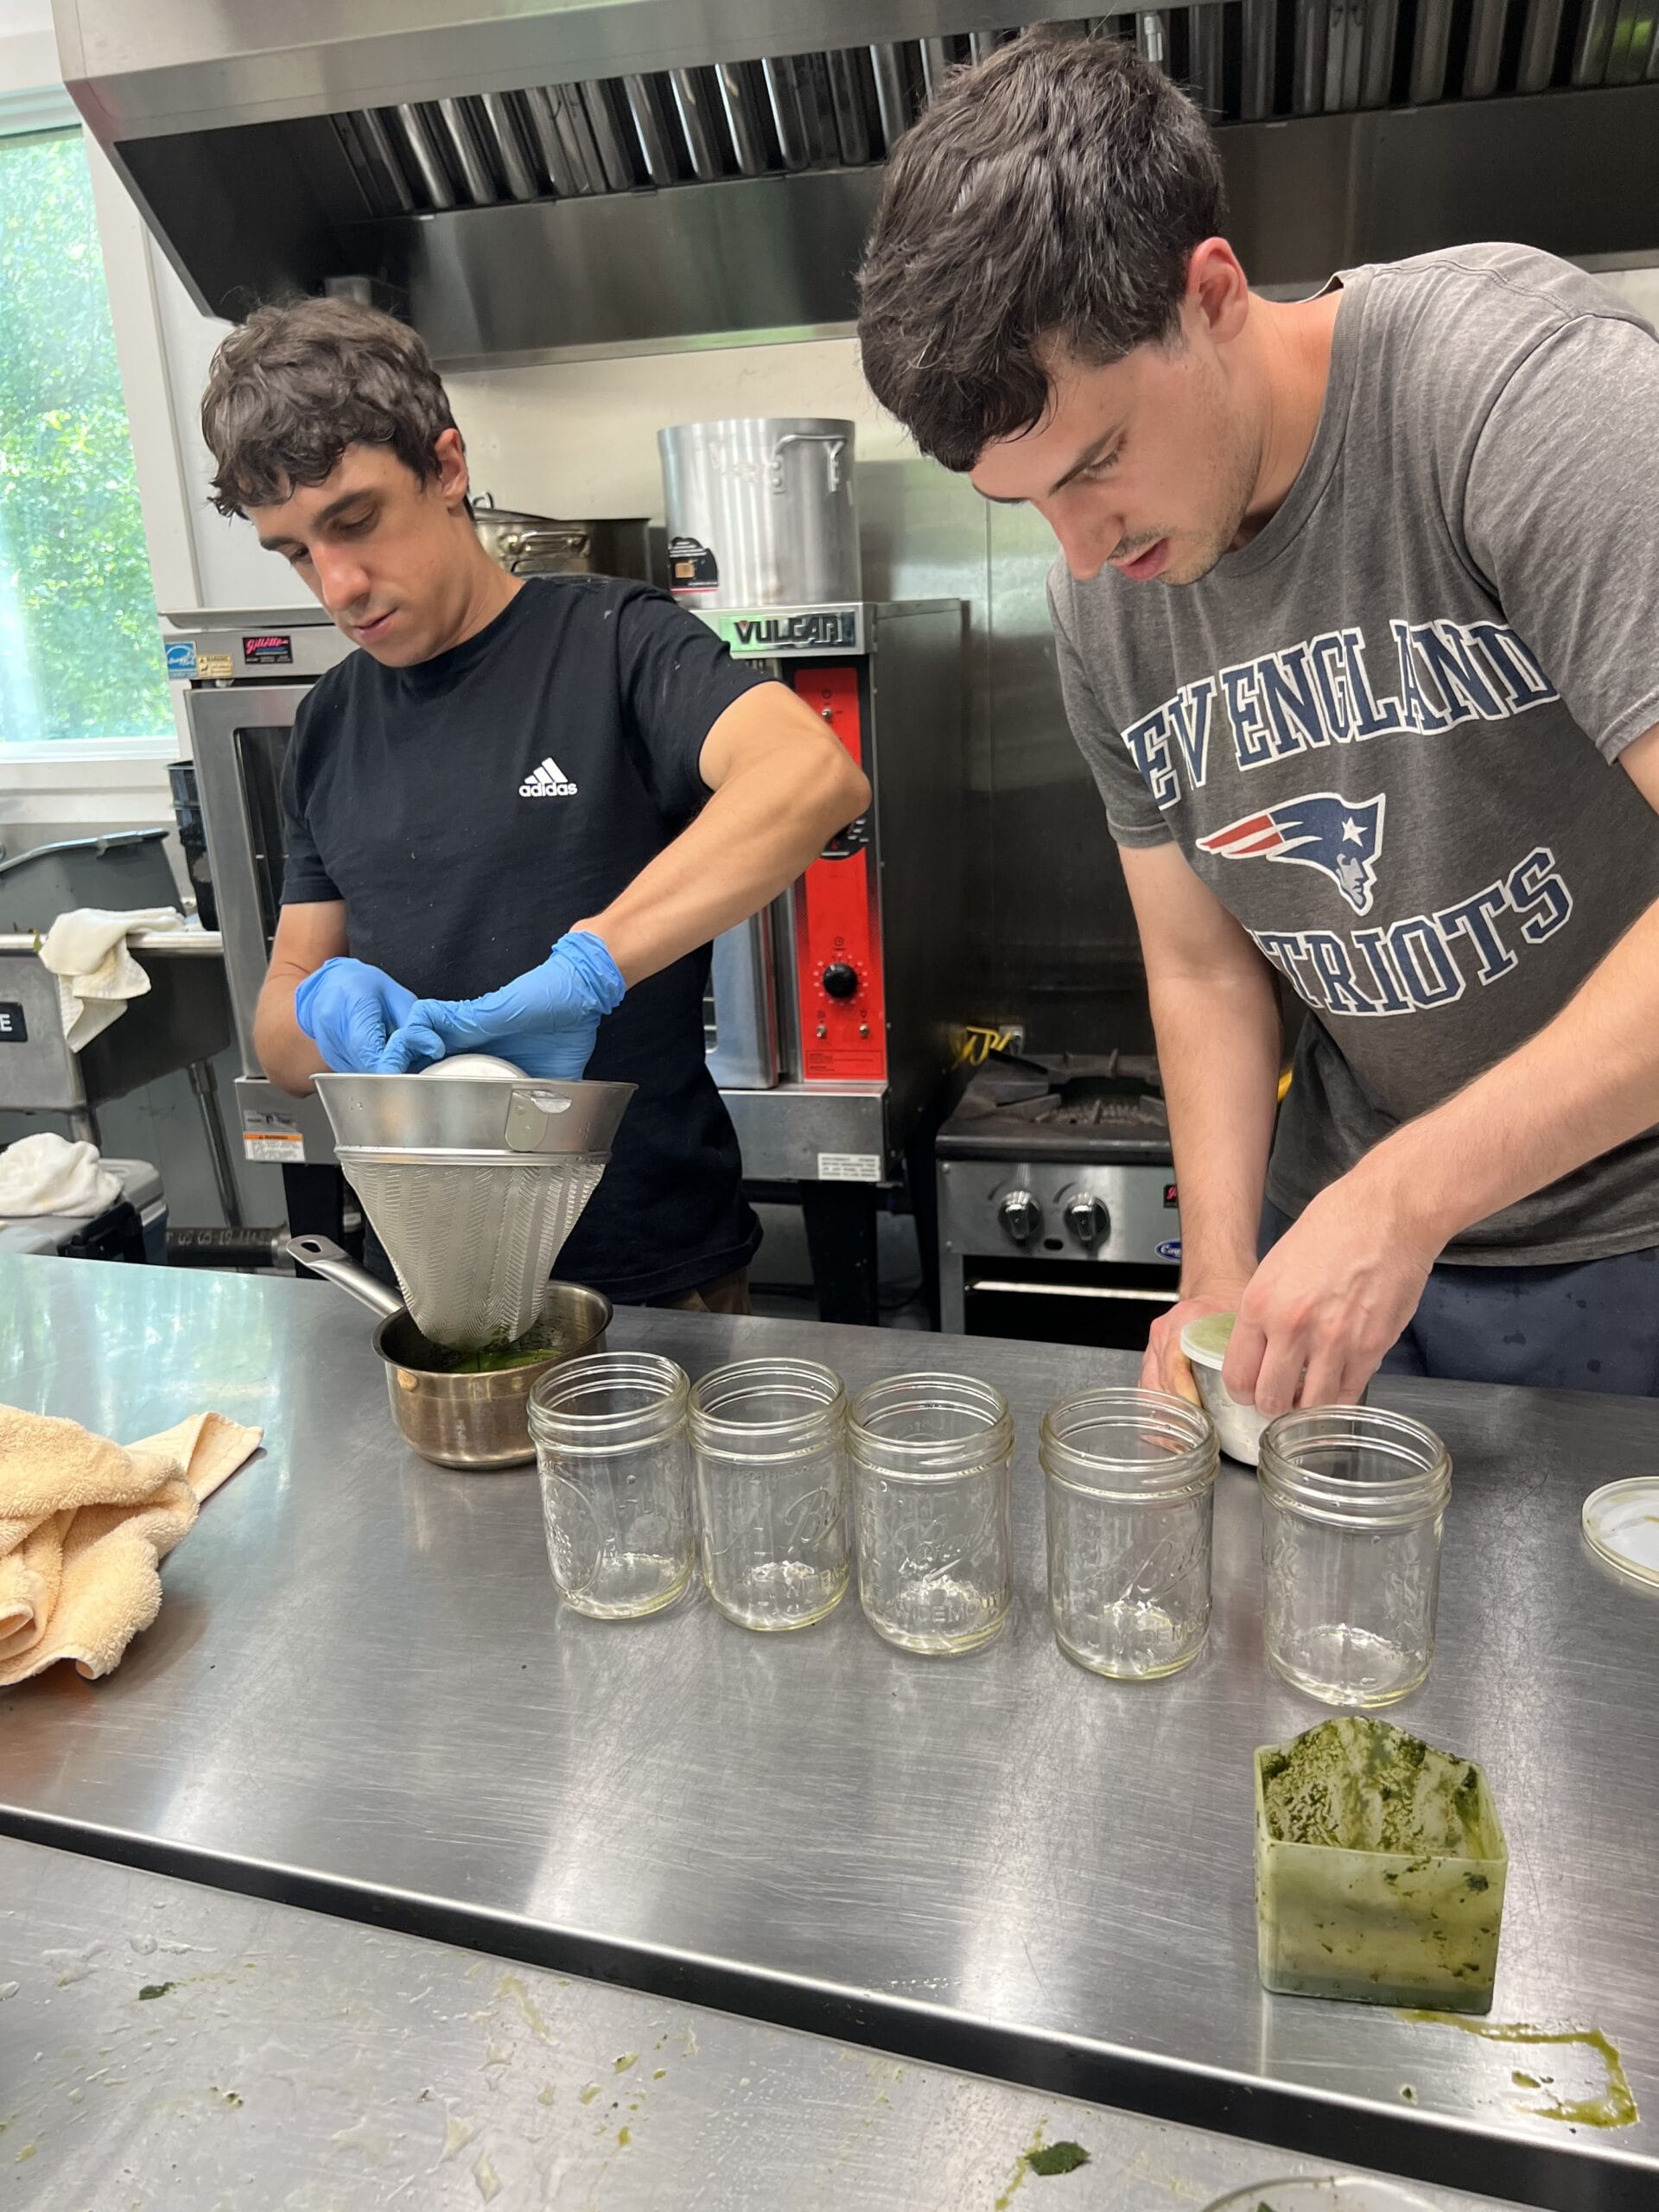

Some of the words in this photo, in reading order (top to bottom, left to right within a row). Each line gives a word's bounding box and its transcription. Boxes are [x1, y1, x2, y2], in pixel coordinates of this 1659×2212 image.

[734, 614, 843, 645] VULCAN
[1218, 619, 1560, 772] ENGLAND
[518, 782, 578, 798] adidas
[1253, 847, 1573, 1017] TRIOTS
